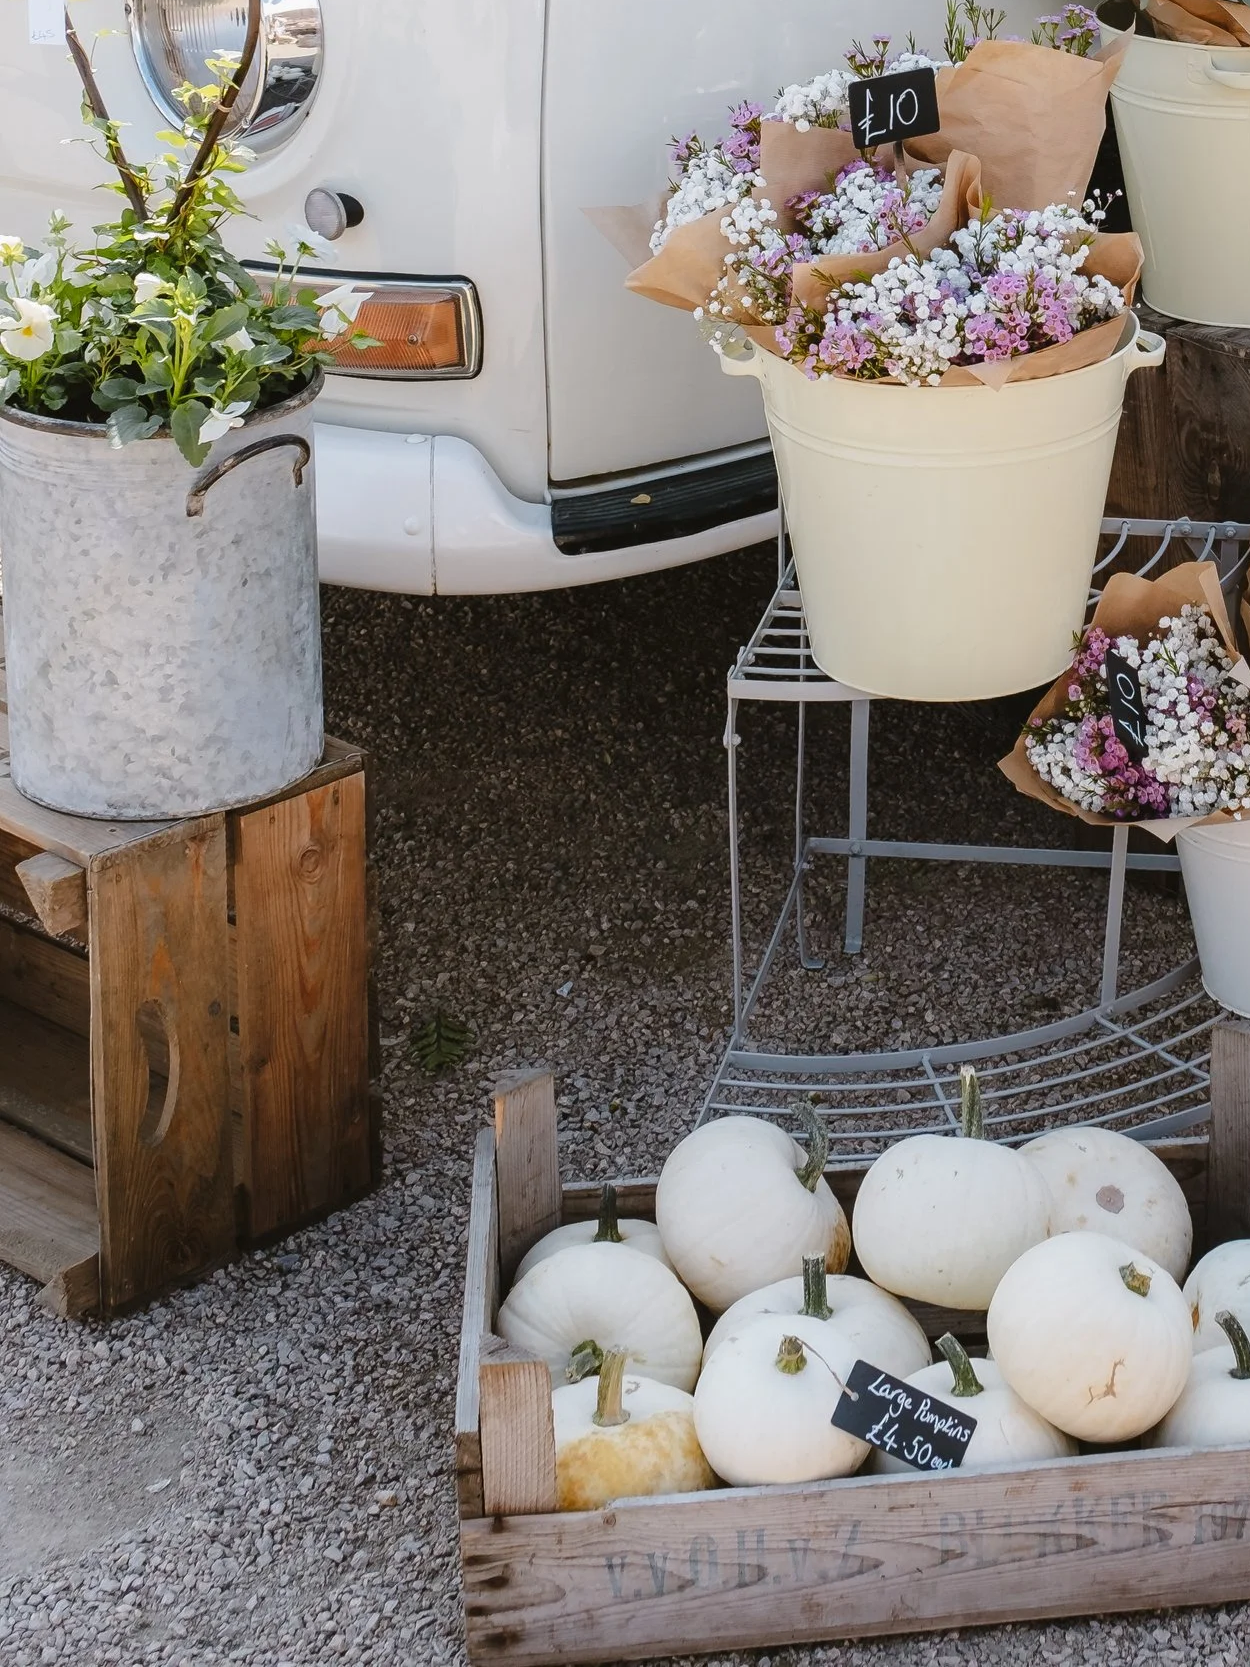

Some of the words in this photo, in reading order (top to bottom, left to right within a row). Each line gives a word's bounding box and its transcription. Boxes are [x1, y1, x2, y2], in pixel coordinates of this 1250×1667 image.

[857, 88, 919, 146] £10
[1116, 672, 1145, 748] £10
[865, 1412, 933, 1466] £4.50
[867, 1373, 913, 1418] Large
[913, 1397, 972, 1443] Pumpkins
